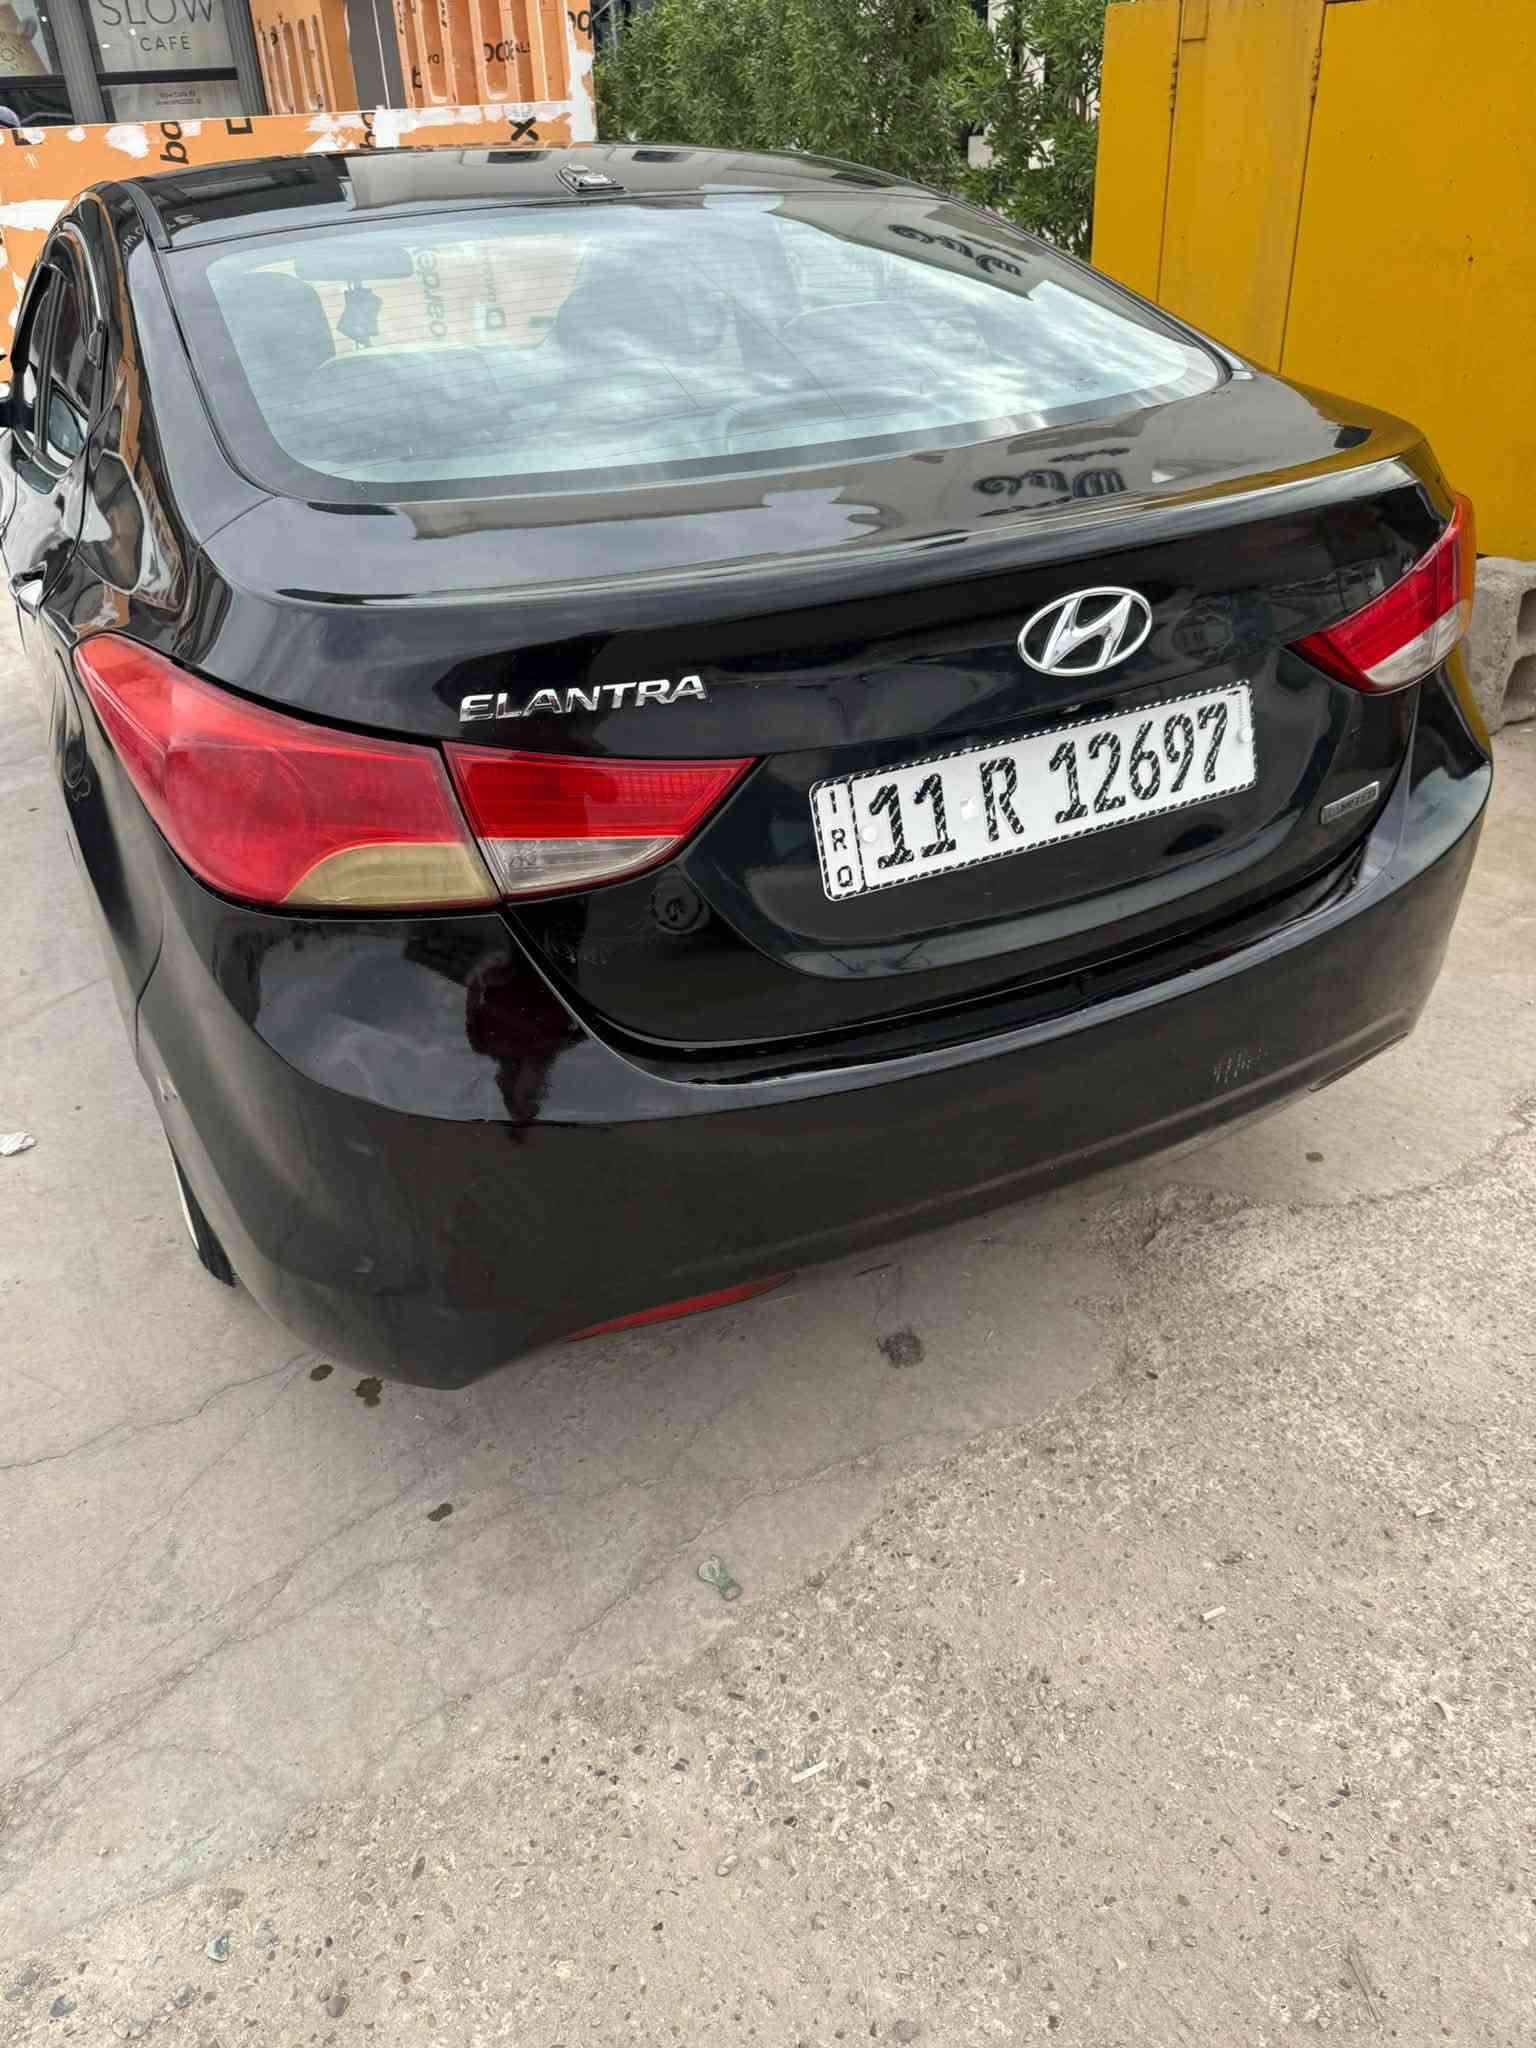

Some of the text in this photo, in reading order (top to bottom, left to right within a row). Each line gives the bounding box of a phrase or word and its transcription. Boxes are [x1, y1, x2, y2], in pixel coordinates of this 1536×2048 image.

[101, 0, 212, 25] SLOW
[459, 675, 706, 722] ELANTRA
[868, 702, 1228, 870] 11 R 12697
